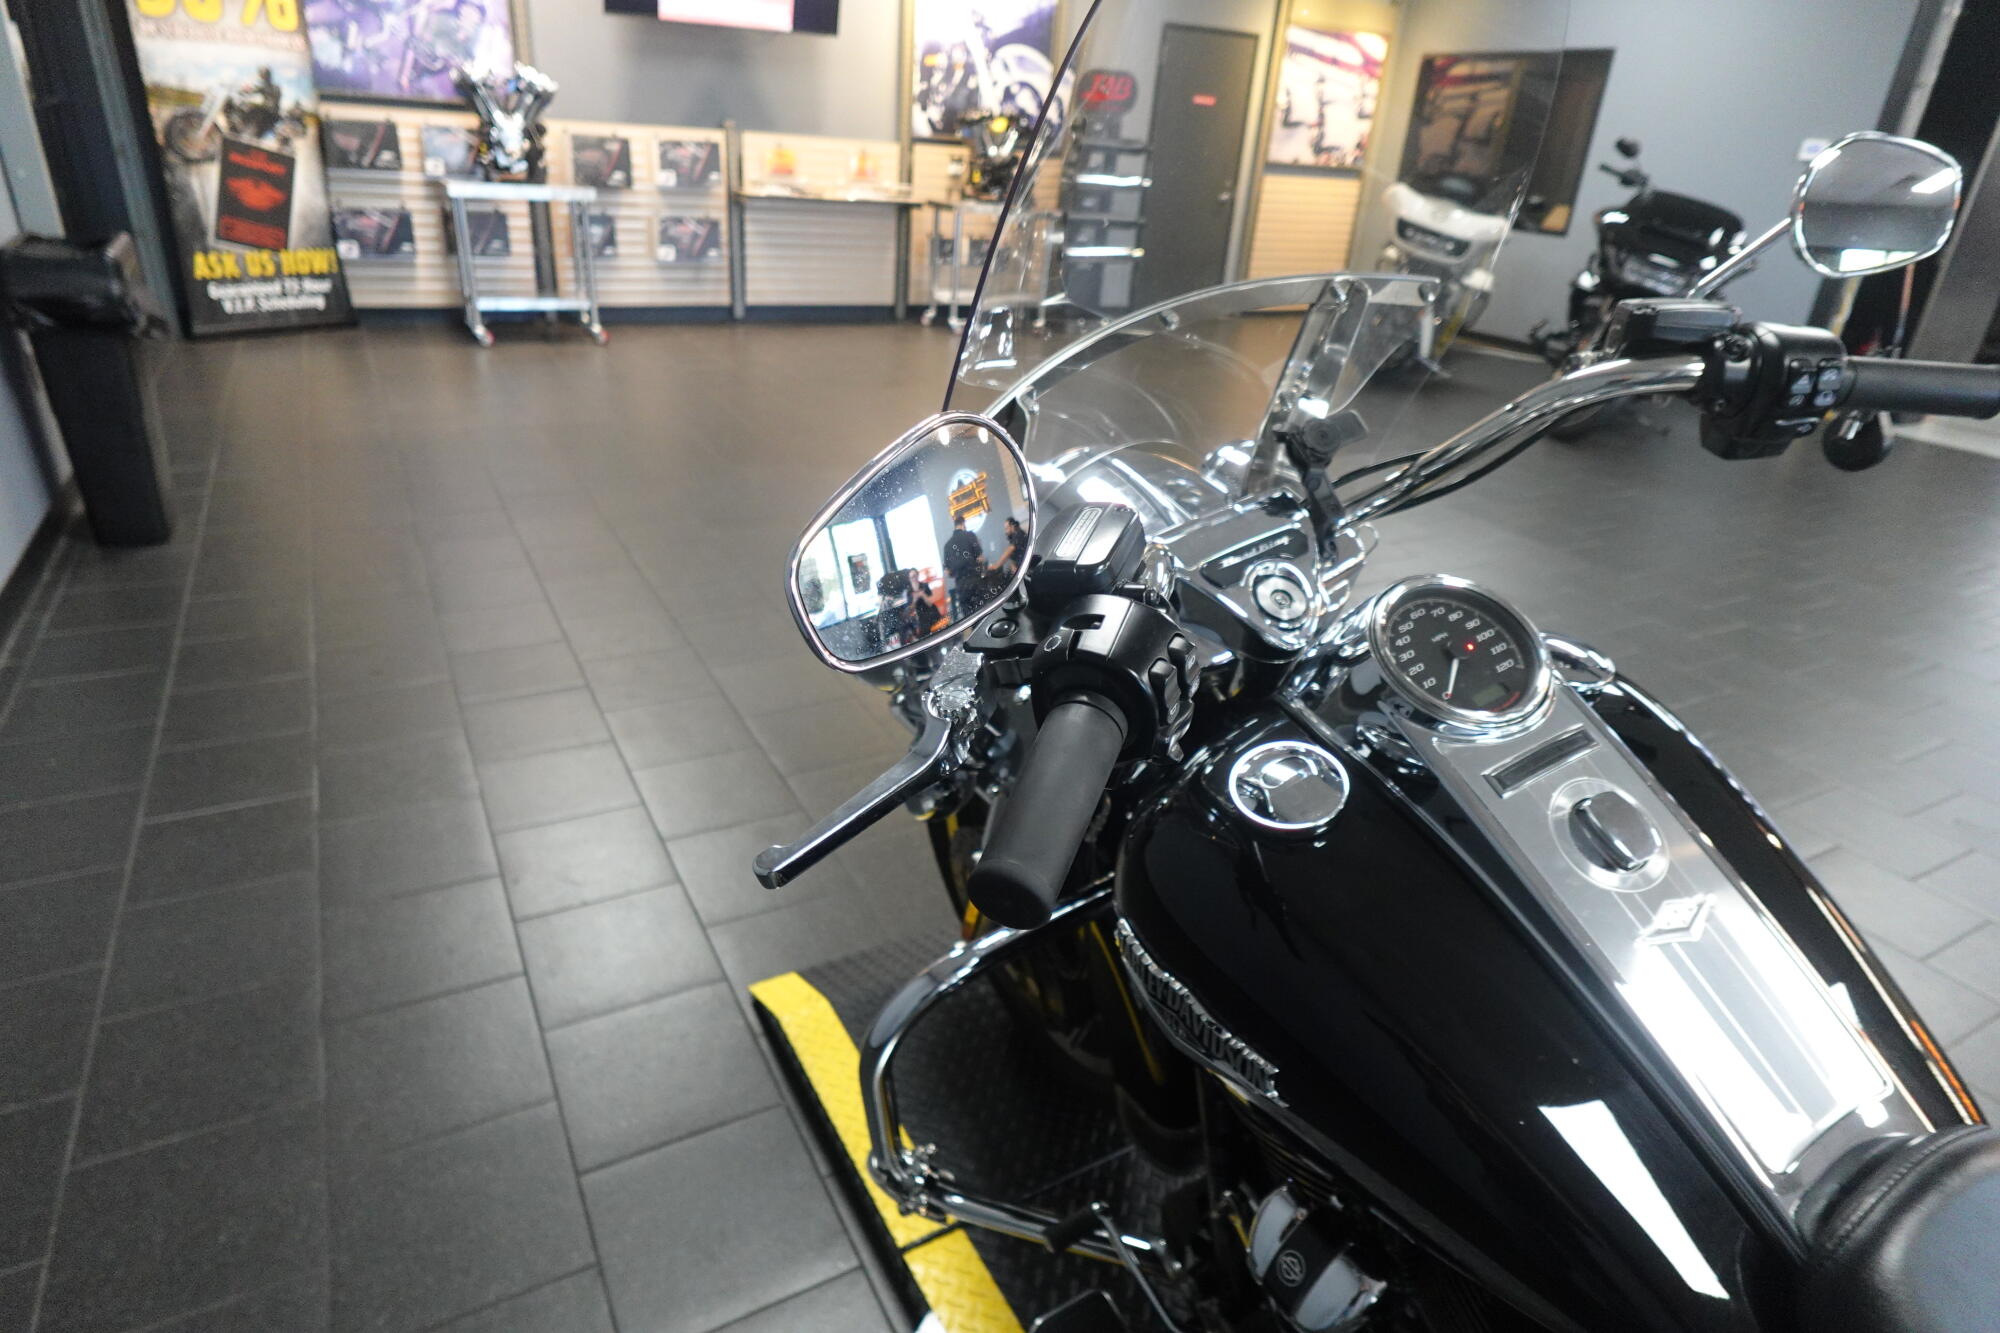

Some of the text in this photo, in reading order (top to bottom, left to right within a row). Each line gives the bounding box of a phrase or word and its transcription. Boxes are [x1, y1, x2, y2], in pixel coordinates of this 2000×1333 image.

[193, 247, 338, 279] ASK US NOW!
[1410, 608, 1426, 619] 60
[1430, 606, 1446, 618] 70
[1448, 610, 1463, 622] 80
[1398, 621, 1414, 634] 50
[1465, 618, 1480, 630] 90
[1395, 635, 1411, 647] 40
[1476, 628, 1495, 642] 100
[1490, 641, 1507, 656] 110
[1399, 649, 1415, 663] 30
[1408, 662, 1425, 676] 20
[1496, 659, 1514, 673] 120
[1423, 677, 1436, 689] 10
